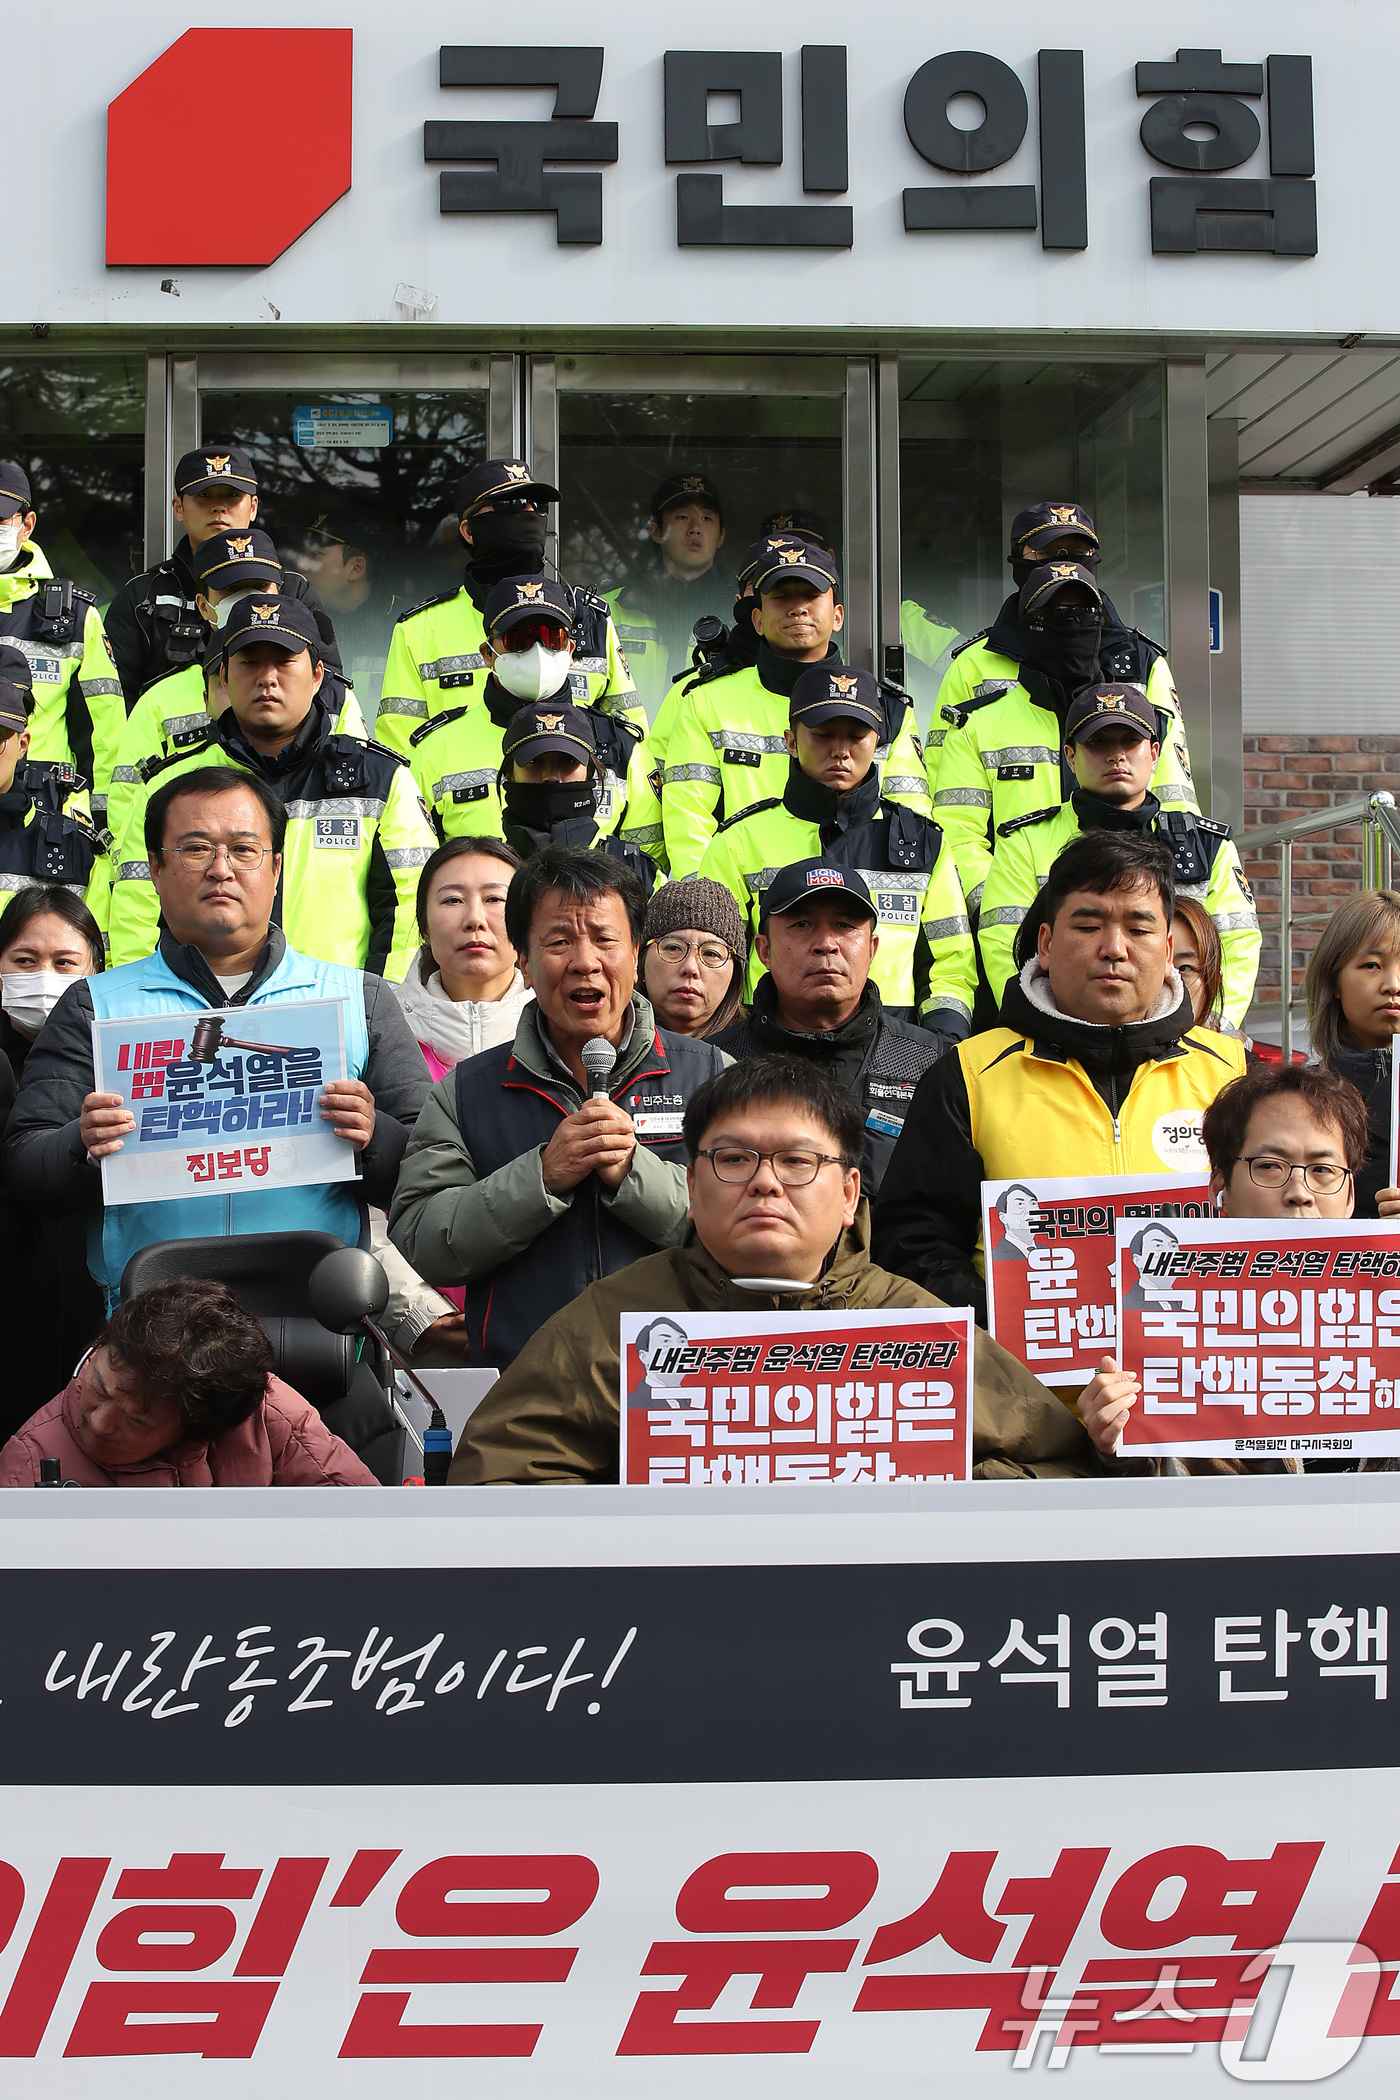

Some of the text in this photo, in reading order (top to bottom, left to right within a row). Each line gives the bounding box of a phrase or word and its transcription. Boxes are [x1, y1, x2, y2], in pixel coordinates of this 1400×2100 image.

[424, 46, 1318, 256] 국민의힘
[323, 409, 344, 417] CCTV
[32, 672, 58, 680] OLICE
[319, 838, 356, 846] POLICE
[807, 869, 844, 880] LIQUI
[808, 876, 844, 886] MOLY
[880, 911, 915, 921] POLICE
[139, 1088, 315, 1142] 탄핵하라!
[642, 1094, 683, 1107] 민주노총
[186, 1146, 272, 1182] 진보당
[1028, 1206, 1116, 1239] 국민의
[1142, 1251, 1249, 1278] 내란주범
[1249, 1251, 1330, 1278] 윤석열
[650, 1341, 959, 1374] 내란주범 윤석열 탄핵하라
[647, 1381, 957, 1447] 국민의힘은
[1234, 1439, 1353, 1451] 윤석열퇴진 대구시국회의
[889, 1603, 1390, 1710] 윤석열 탄핵
[44, 1624, 638, 1729] 내란동조범이다!
[614, 1840, 1326, 2057] 윤석열
